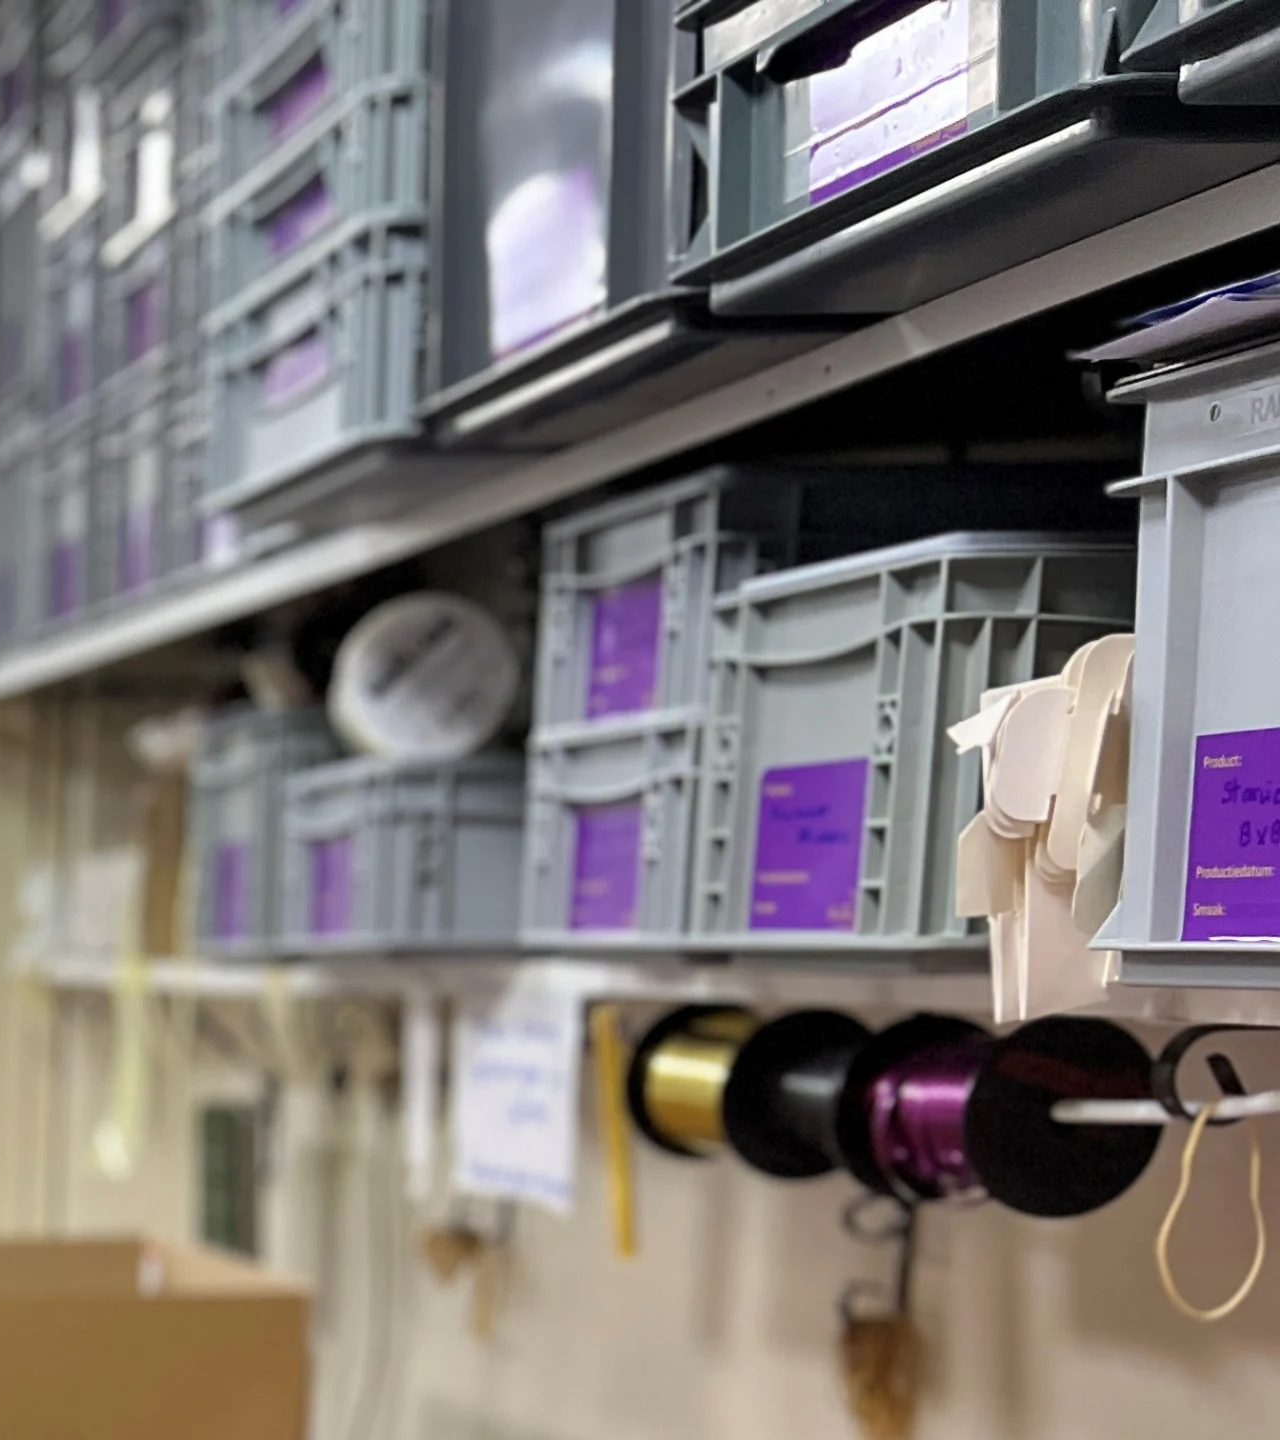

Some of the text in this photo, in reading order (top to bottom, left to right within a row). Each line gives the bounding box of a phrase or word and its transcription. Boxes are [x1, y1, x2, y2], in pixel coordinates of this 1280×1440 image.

[1203, 755, 1243, 769] Product:
[1196, 865, 1276, 880] Productiedatum:
[1193, 903, 1227, 917] Smaak:
